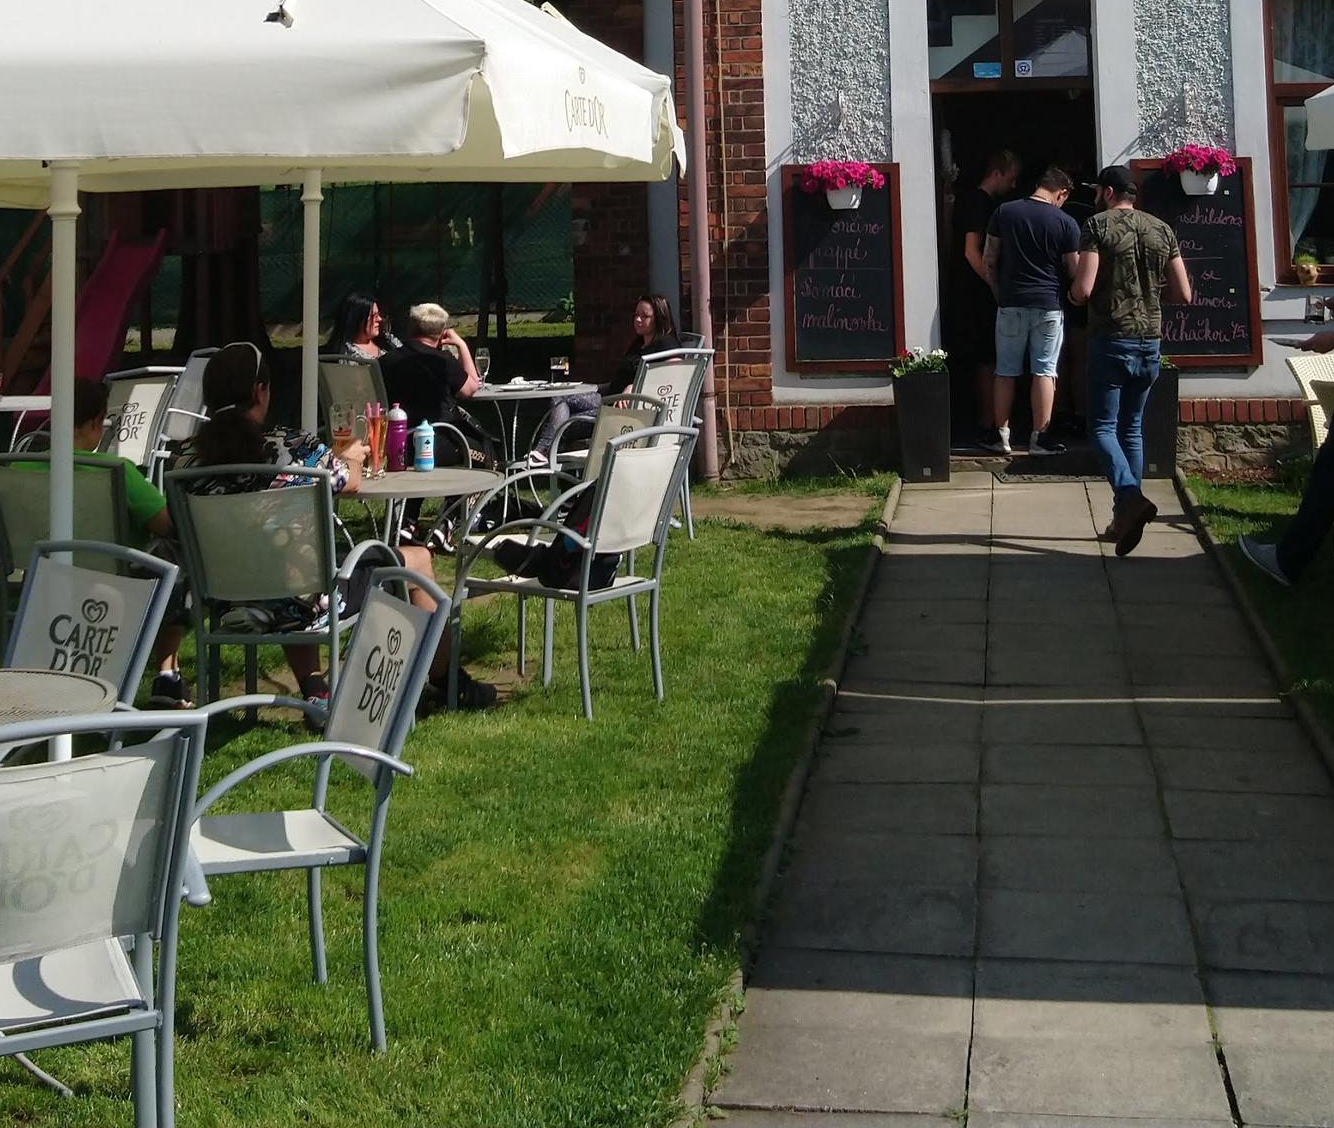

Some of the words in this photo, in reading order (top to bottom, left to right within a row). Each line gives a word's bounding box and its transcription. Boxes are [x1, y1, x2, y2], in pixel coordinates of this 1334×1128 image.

[564, 89, 587, 132] CARTE
[49, 613, 118, 656] CARTE
[365, 645, 404, 693] CARTE
